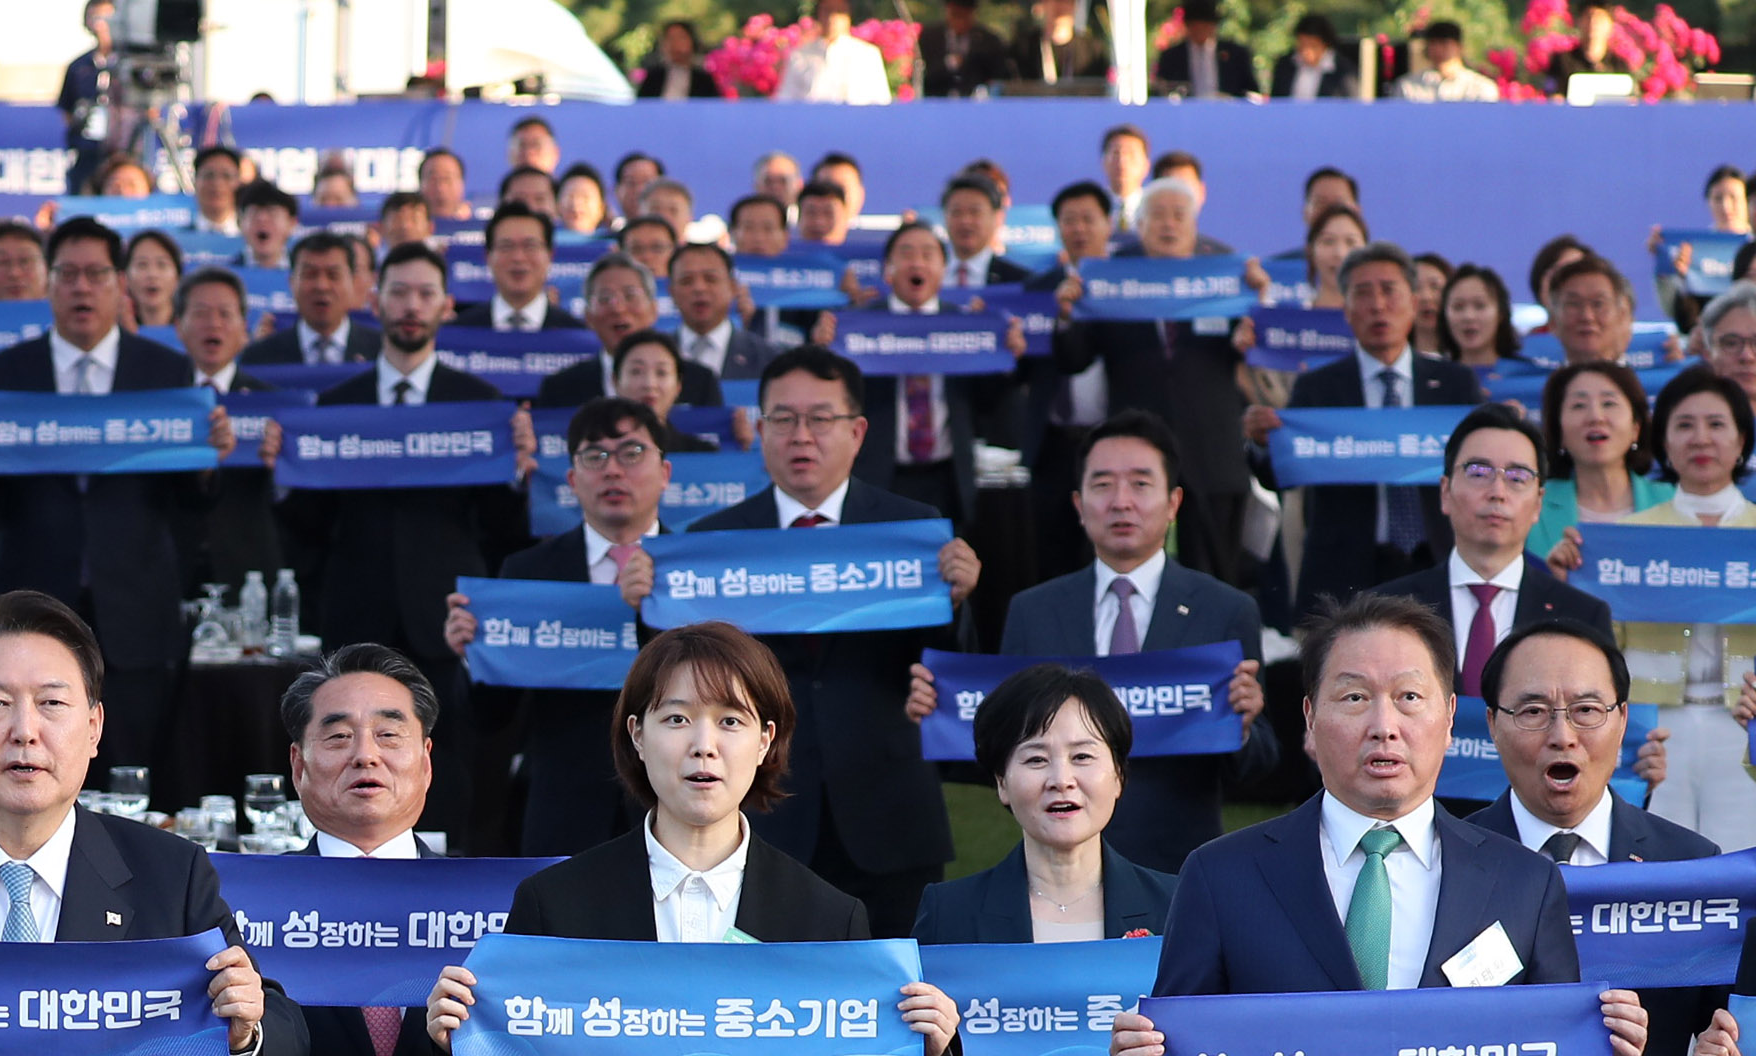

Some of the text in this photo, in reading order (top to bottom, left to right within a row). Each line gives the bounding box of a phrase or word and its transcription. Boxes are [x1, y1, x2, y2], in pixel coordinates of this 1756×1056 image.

[104, 417, 193, 443] 중소기업
[406, 430, 493, 457] 대한민국
[667, 559, 922, 600] 함께 성장하는 중소기업
[1598, 559, 1640, 586] 함께
[1645, 559, 1719, 588] 성장하는
[485, 618, 530, 647] 함께
[534, 618, 615, 648] 성장하는
[282, 910, 399, 949] 성장하는
[1591, 898, 1740, 934] 대한민국
[18, 988, 182, 1031] 대한민국
[504, 997, 878, 1039] 함께 성장하는 중소기업
[964, 1000, 1078, 1034] 성장하는
